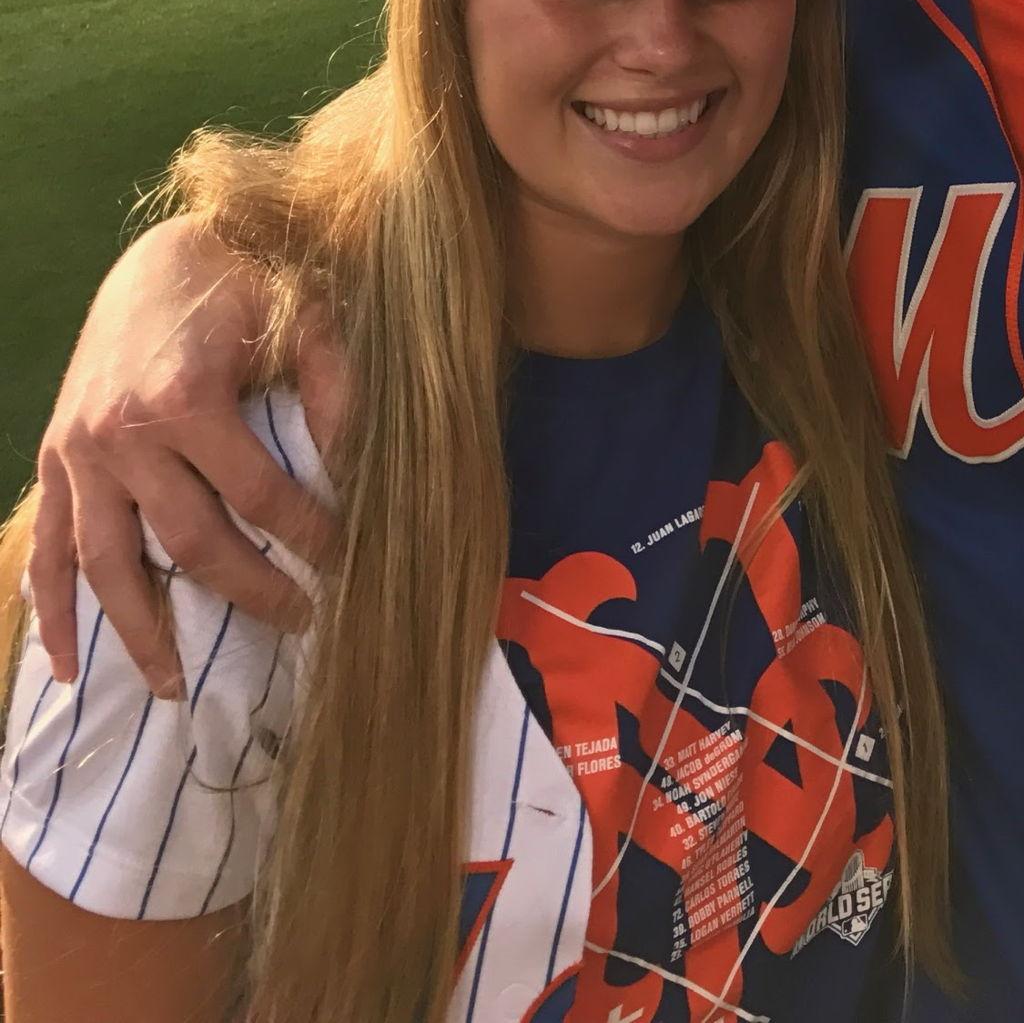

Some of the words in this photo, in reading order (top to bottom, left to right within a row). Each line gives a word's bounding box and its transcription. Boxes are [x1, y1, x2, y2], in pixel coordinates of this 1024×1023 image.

[630, 541, 646, 555] 12.
[646, 522, 674, 546] JUAN
[575, 736, 618, 757] TEJADA
[698, 720, 731, 752] HARVEY
[577, 754, 622, 777] FLORES
[676, 758, 703, 782] JACOB
[665, 782, 692, 804] NOAH
[676, 801, 692, 815] 49.
[694, 785, 715, 807] JON
[670, 822, 686, 839] 40.
[682, 835, 698, 851] 32.
[685, 882, 717, 914] CARLOS
[717, 859, 750, 890] TORRES
[687, 900, 717, 929] BOBBY
[717, 876, 755, 909] PARNELL
[690, 920, 719, 945] LOGAN
[720, 890, 755, 925] VERRETT
